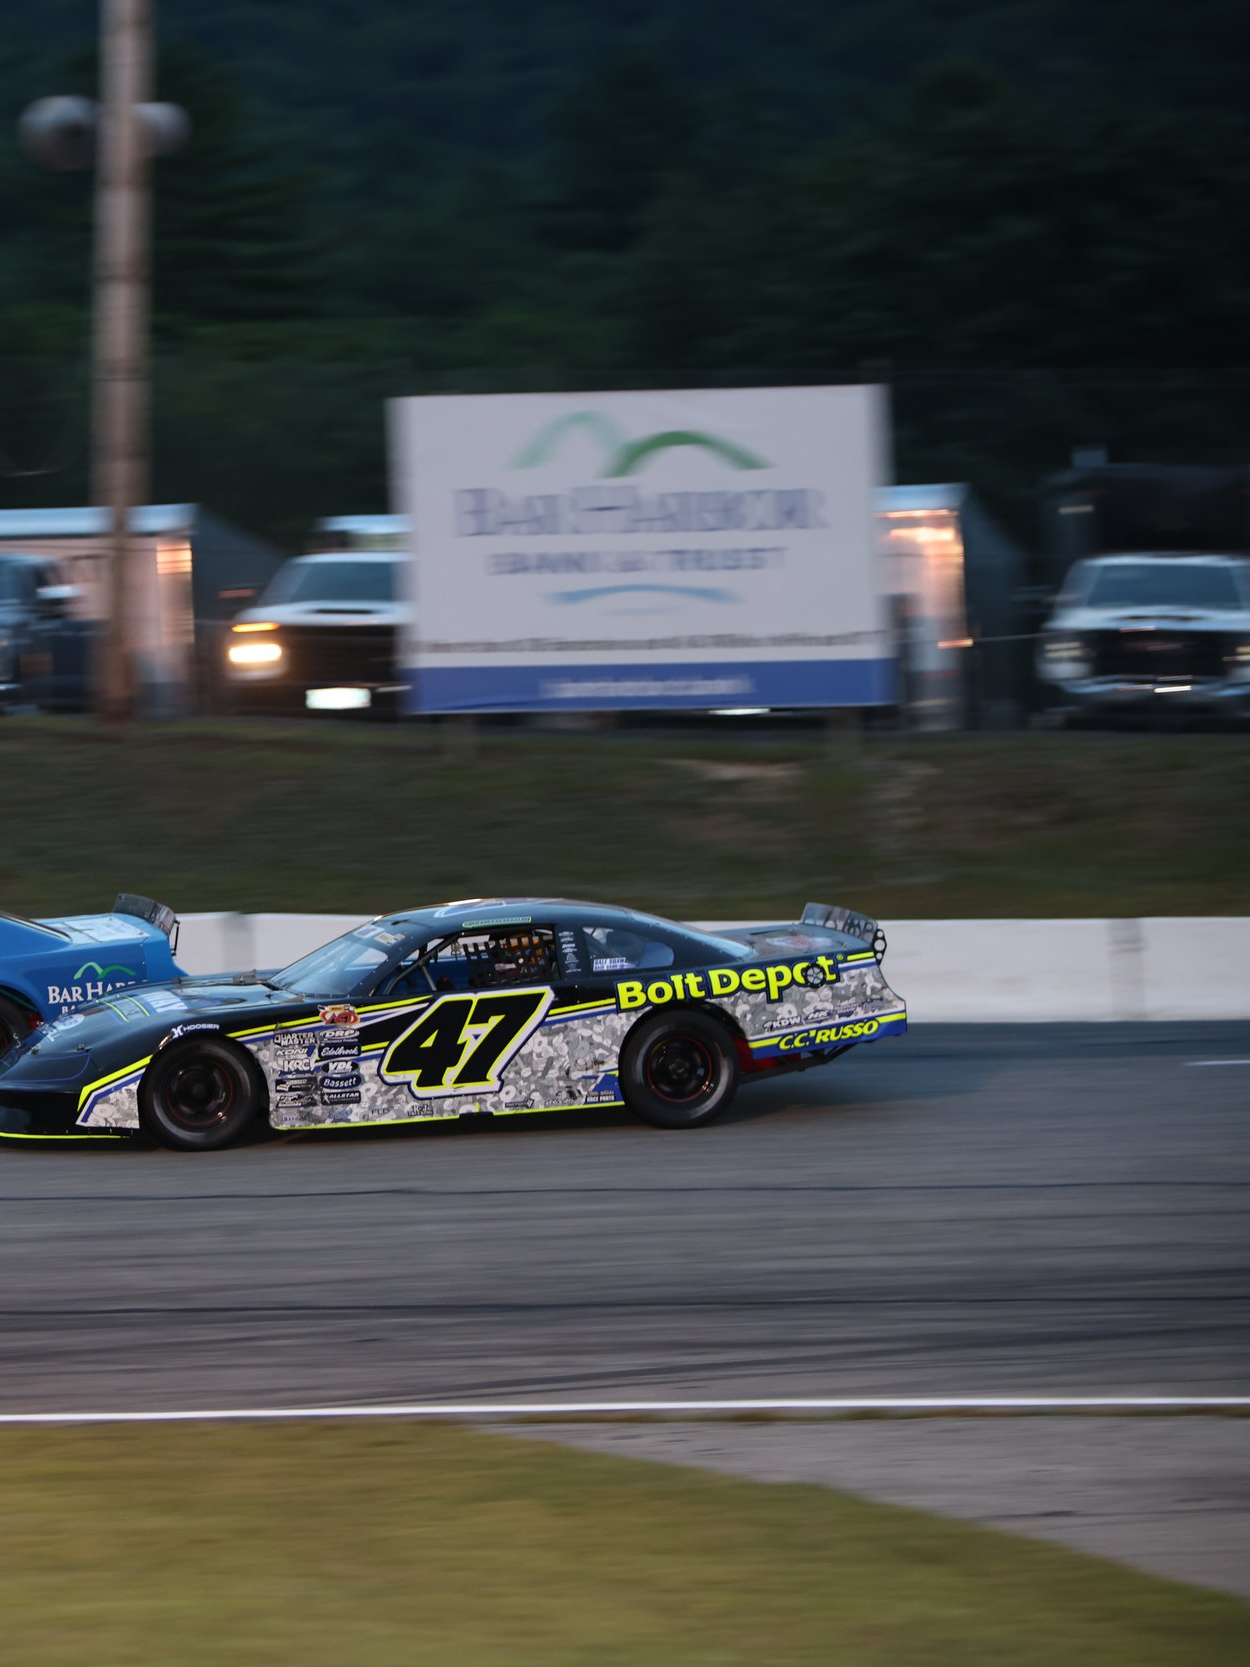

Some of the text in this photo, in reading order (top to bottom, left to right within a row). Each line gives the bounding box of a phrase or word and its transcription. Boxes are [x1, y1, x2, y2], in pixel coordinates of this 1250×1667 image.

[47, 985, 85, 1004] BAR
[618, 955, 837, 1010] Bolt Depot
[382, 989, 551, 1091] 47
[815, 1020, 879, 1044] RUSSO
